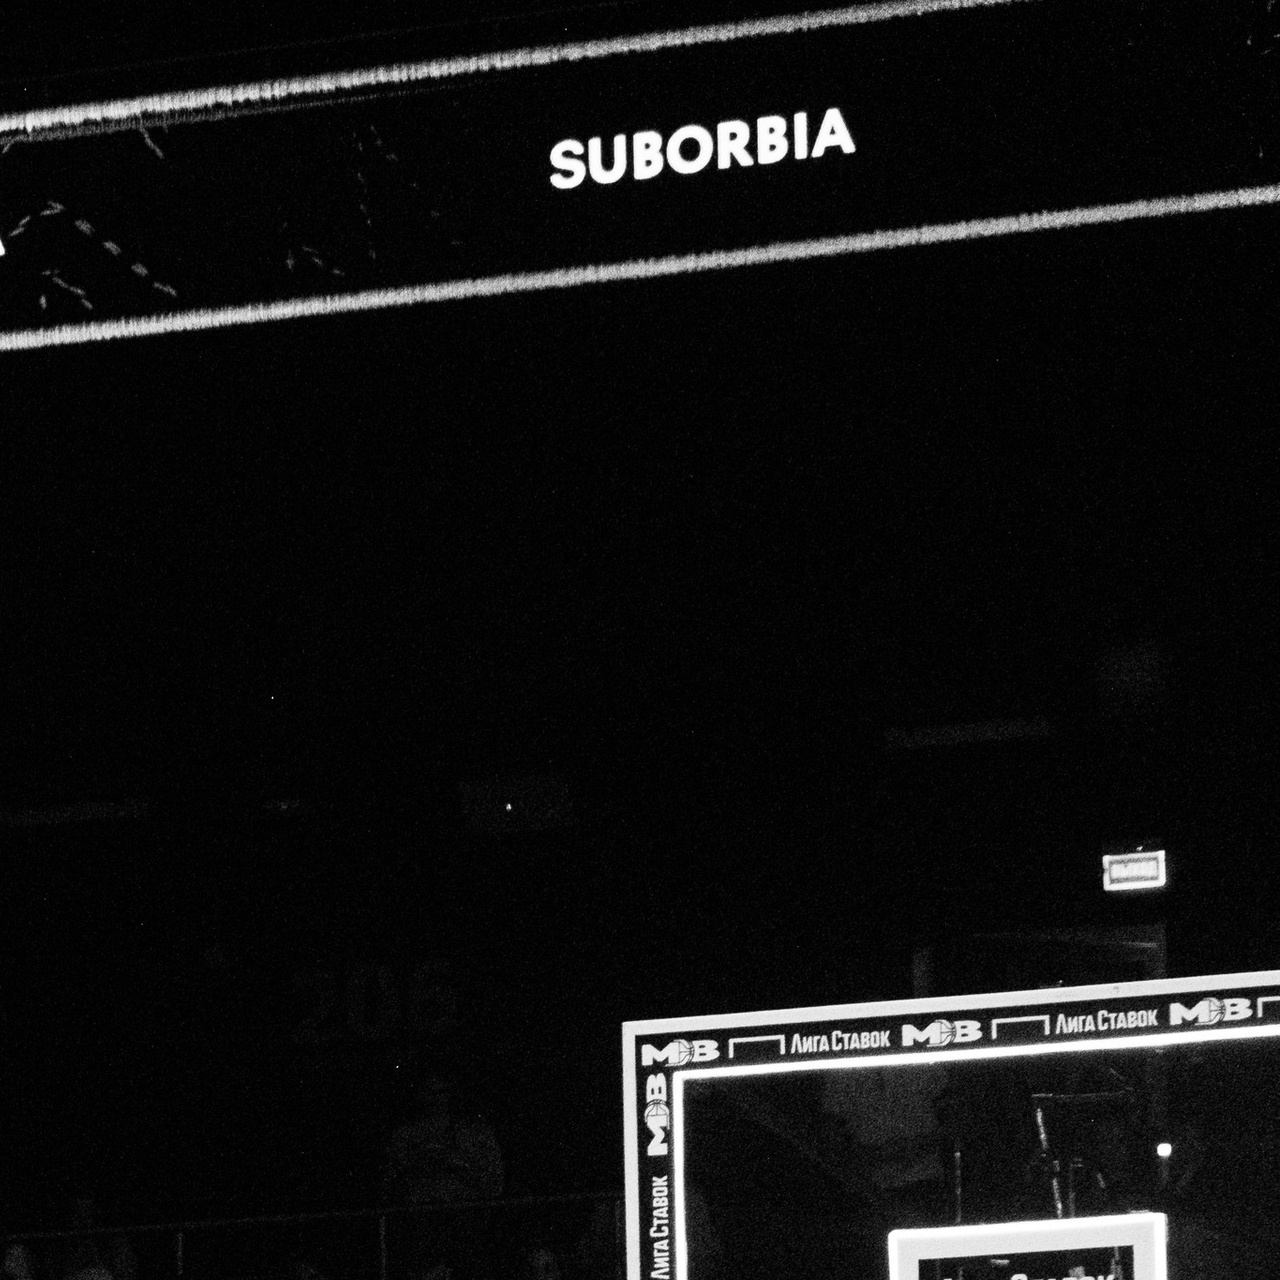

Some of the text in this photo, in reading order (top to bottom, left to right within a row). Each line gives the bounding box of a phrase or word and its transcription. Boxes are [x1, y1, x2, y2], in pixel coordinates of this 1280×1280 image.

[550, 107, 856, 189] SUBORBIA
[790, 1029, 891, 1054] ЛИГА СТАВОК
[1055, 1009, 1159, 1035] ЛИГА СТАВОК
[649, 1175, 670, 1280] ЛИГА СТАВОК
